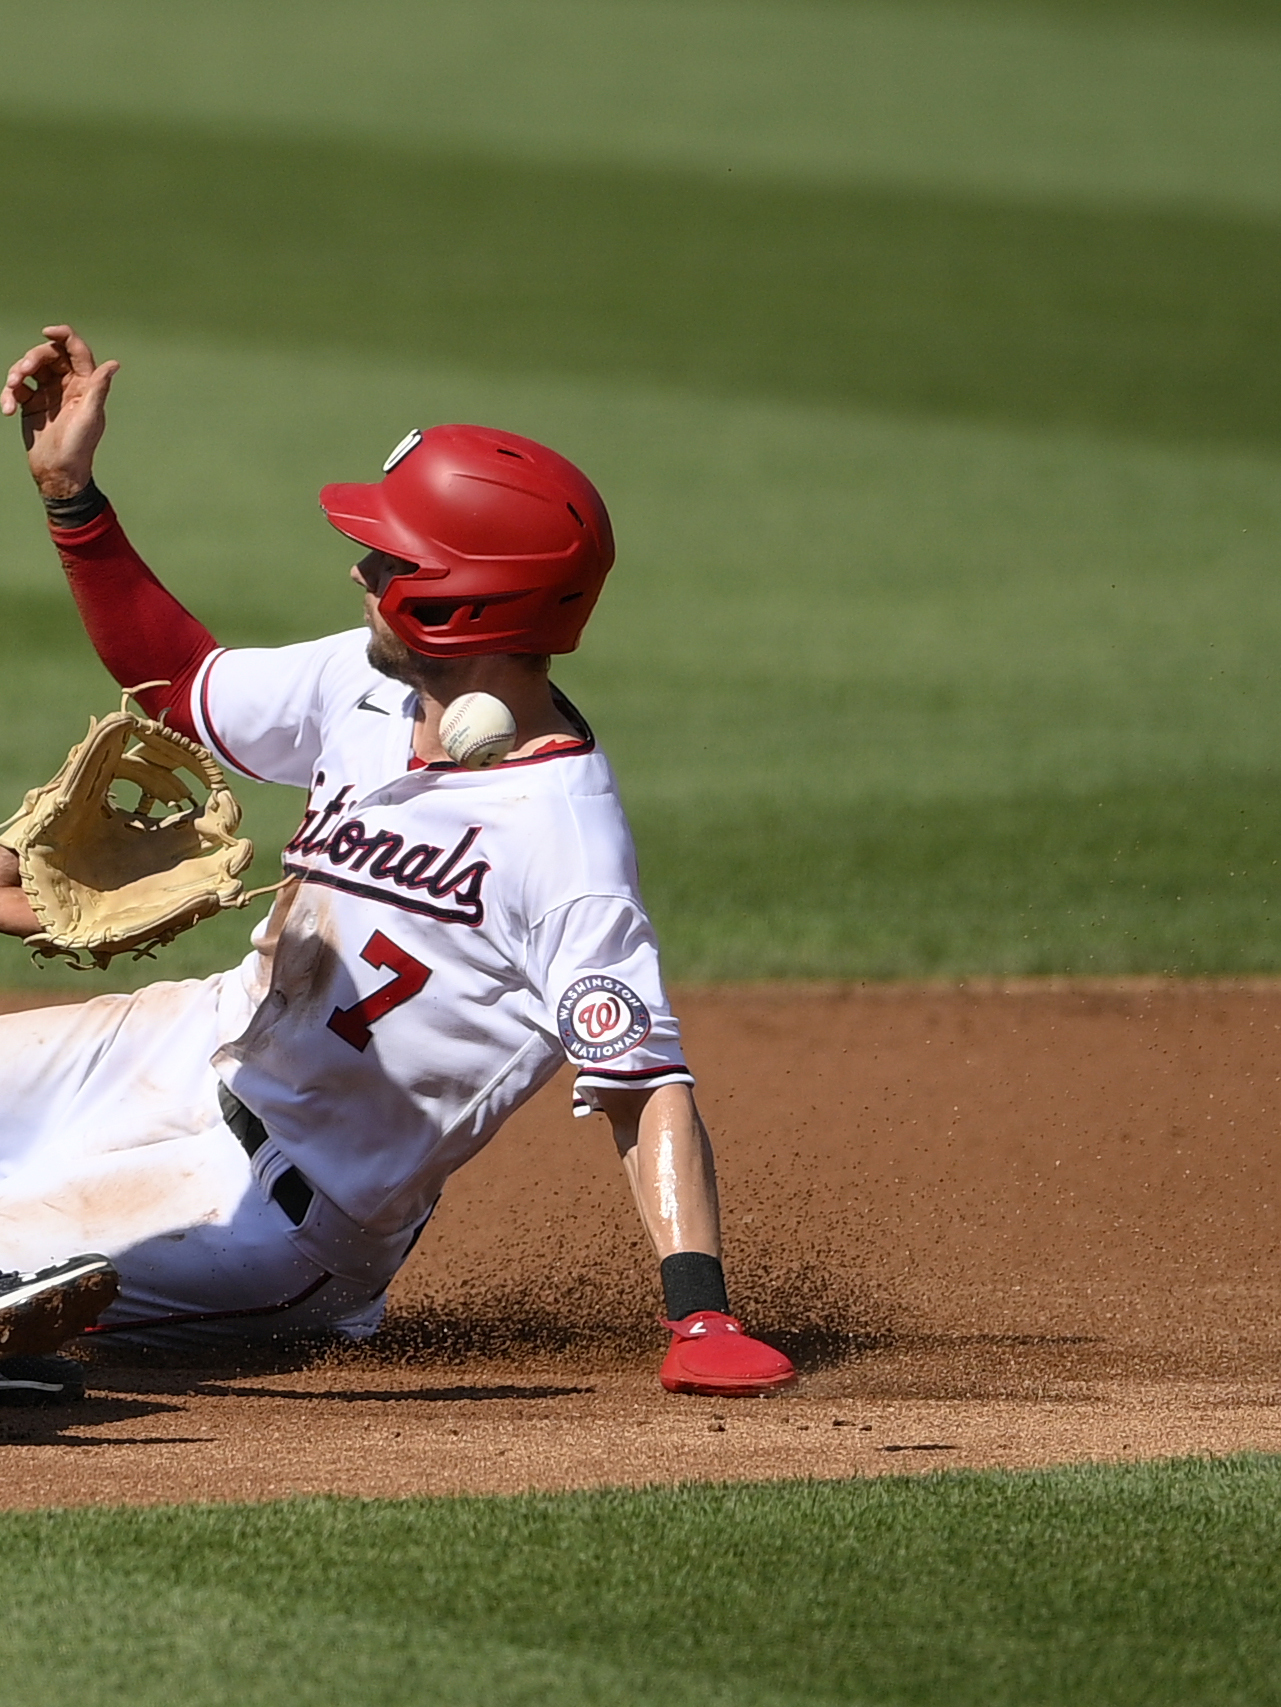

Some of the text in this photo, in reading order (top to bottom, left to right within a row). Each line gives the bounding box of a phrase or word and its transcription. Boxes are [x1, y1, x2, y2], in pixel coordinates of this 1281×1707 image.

[326, 928, 433, 1053] 7
[558, 977, 641, 1020] WASHINGTON
[578, 996, 620, 1038] W
[570, 1023, 645, 1059] NATIONALS
